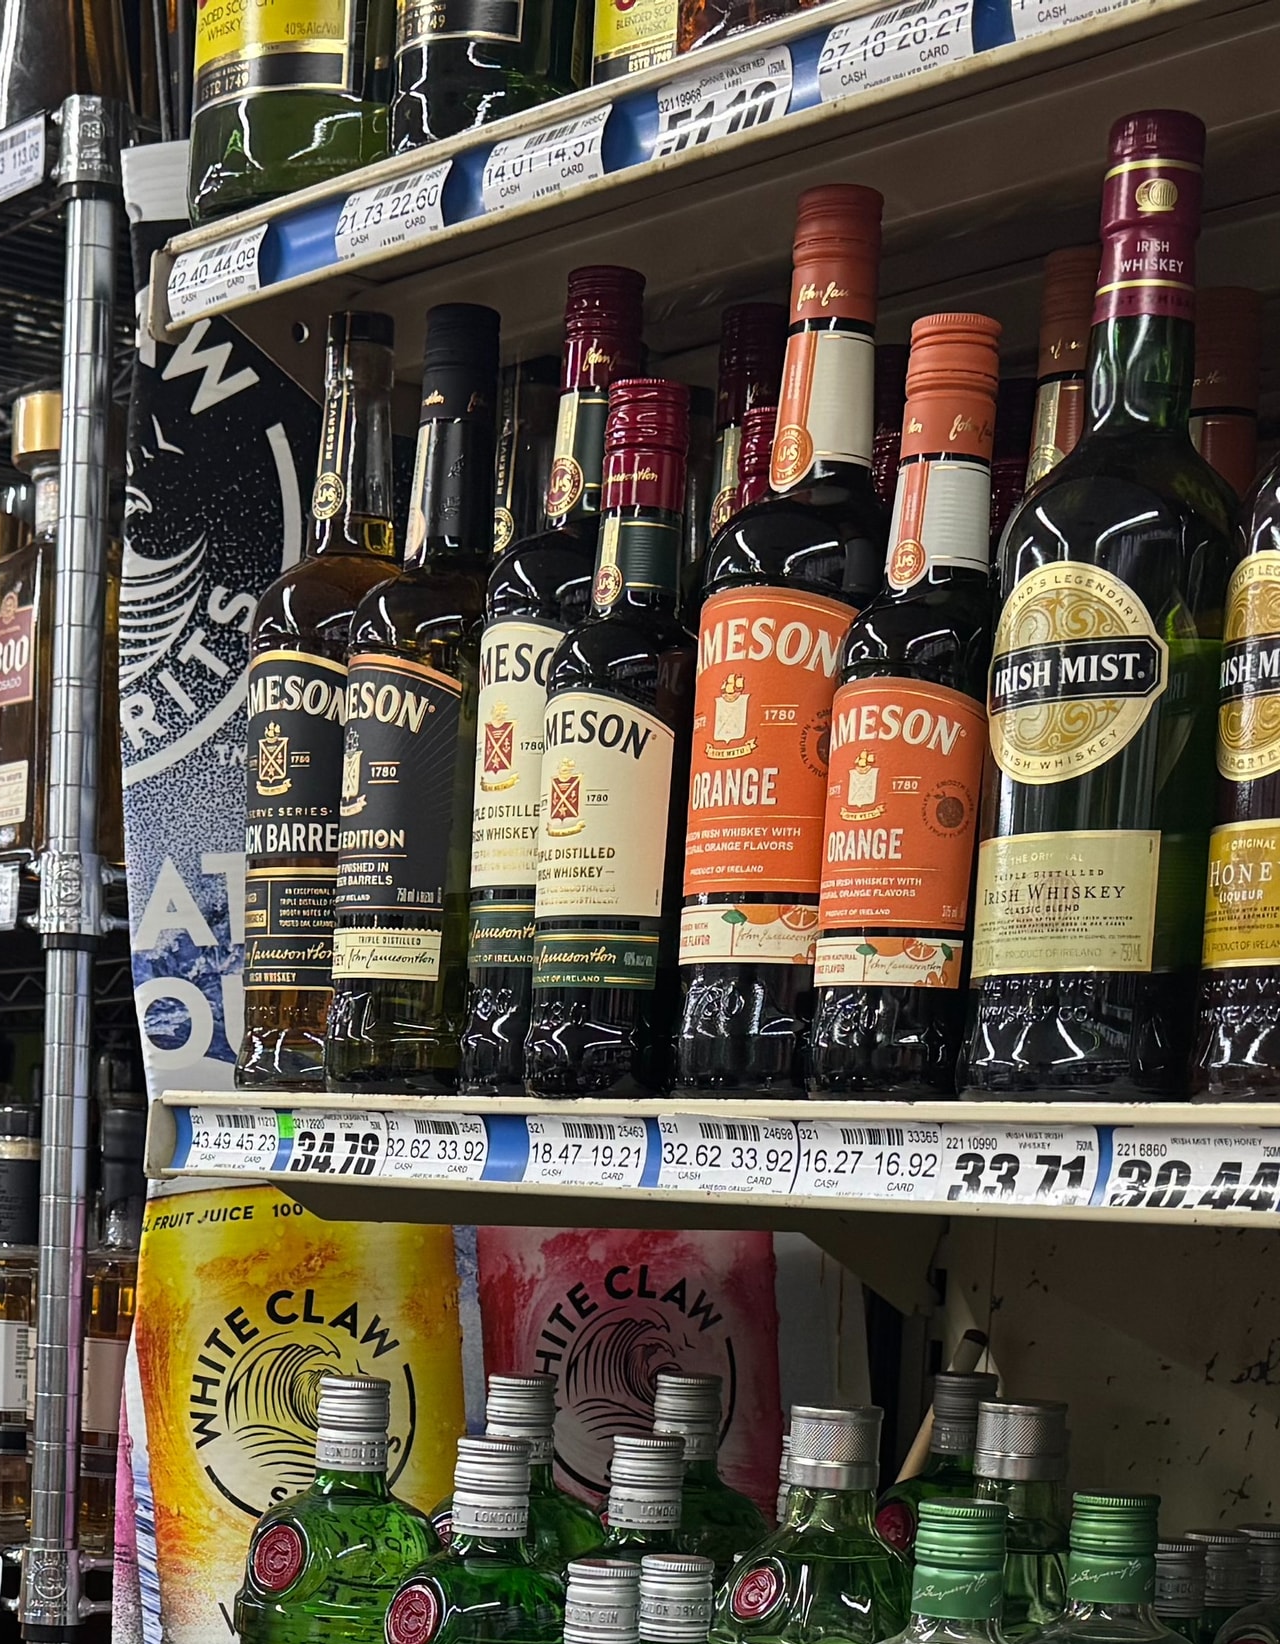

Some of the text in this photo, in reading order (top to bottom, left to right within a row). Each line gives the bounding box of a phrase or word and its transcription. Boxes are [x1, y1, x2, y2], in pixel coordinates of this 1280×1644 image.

[338, 185, 439, 235] 21.73 22.60
[1137, 240, 1170, 254] IRISH
[1120, 259, 1184, 274] WHISKEY
[764, 709, 796, 721] 1780
[370, 766, 397, 779] 1780
[692, 766, 779, 810] ORANGE
[892, 779, 919, 792] 1780
[343, 830, 405, 848] EDITION
[826, 827, 904, 862] ORANGE
[1232, 838, 1276, 851] ORIGINAL
[557, 846, 616, 861] DISTILLED
[348, 875, 393, 886] BARRELS
[553, 866, 603, 880] WHISKEY
[985, 884, 1126, 907] IRISH WHISKEY
[1219, 889, 1263, 902] LIQUEUR
[192, 1130, 232, 1151] 43.49
[236, 1131, 276, 1153] 45.23
[531, 1142, 643, 1169] 18.47 19.21
[663, 1142, 793, 1175] 32.62 33.92
[802, 1148, 937, 1178] 16.27 16.92
[603, 1265, 723, 1332] CLAW
[190, 1288, 401, 1450] WHITE CLAW
